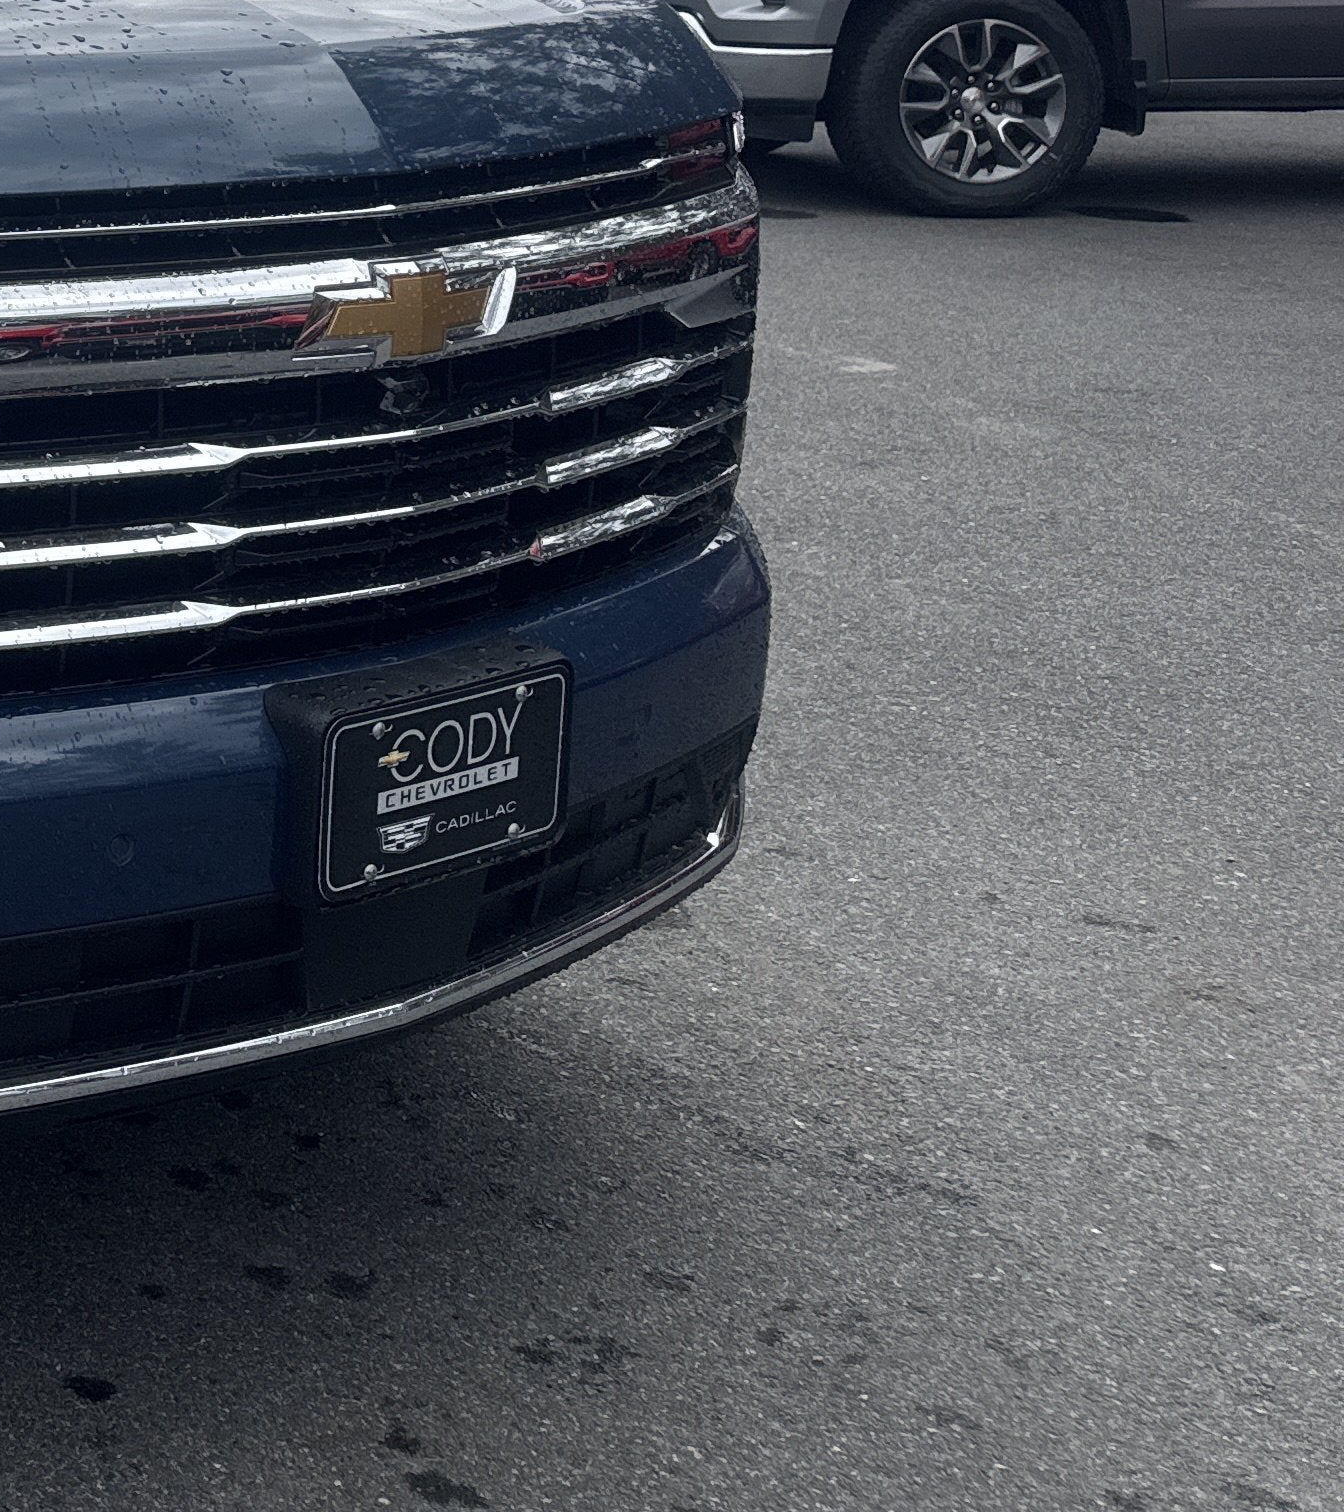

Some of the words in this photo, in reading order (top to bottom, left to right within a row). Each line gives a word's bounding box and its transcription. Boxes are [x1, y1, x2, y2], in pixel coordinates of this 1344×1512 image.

[390, 701, 523, 782] CODY
[385, 761, 513, 809] CHEVROLET
[435, 800, 518, 834] CADILLAC
